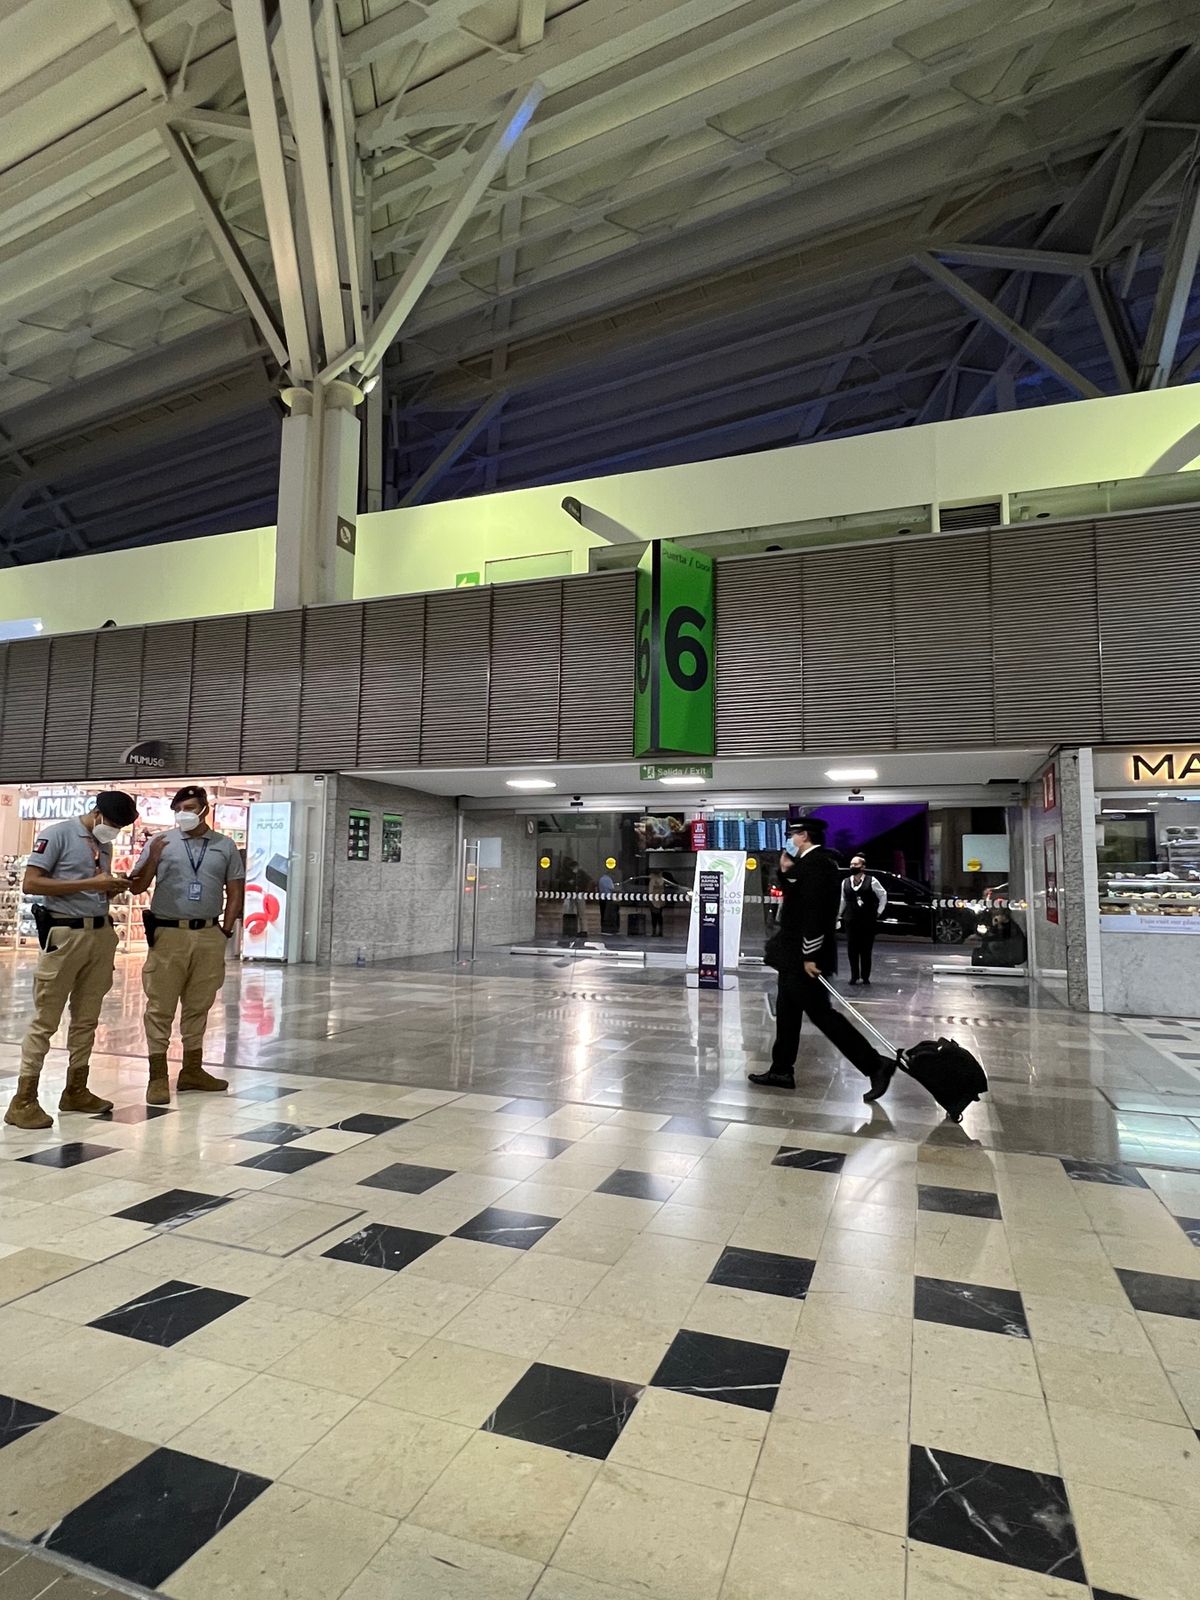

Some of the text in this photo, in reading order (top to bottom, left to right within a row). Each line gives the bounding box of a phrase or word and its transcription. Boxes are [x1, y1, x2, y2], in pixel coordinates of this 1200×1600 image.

[688, 556, 694, 567] /
[637, 608, 650, 695] 6
[664, 605, 709, 692] 6
[129, 754, 165, 767] MUMUSO
[1132, 753, 1200, 781] MA
[657, 767, 683, 776] Salida
[689, 767, 706, 775] Exit
